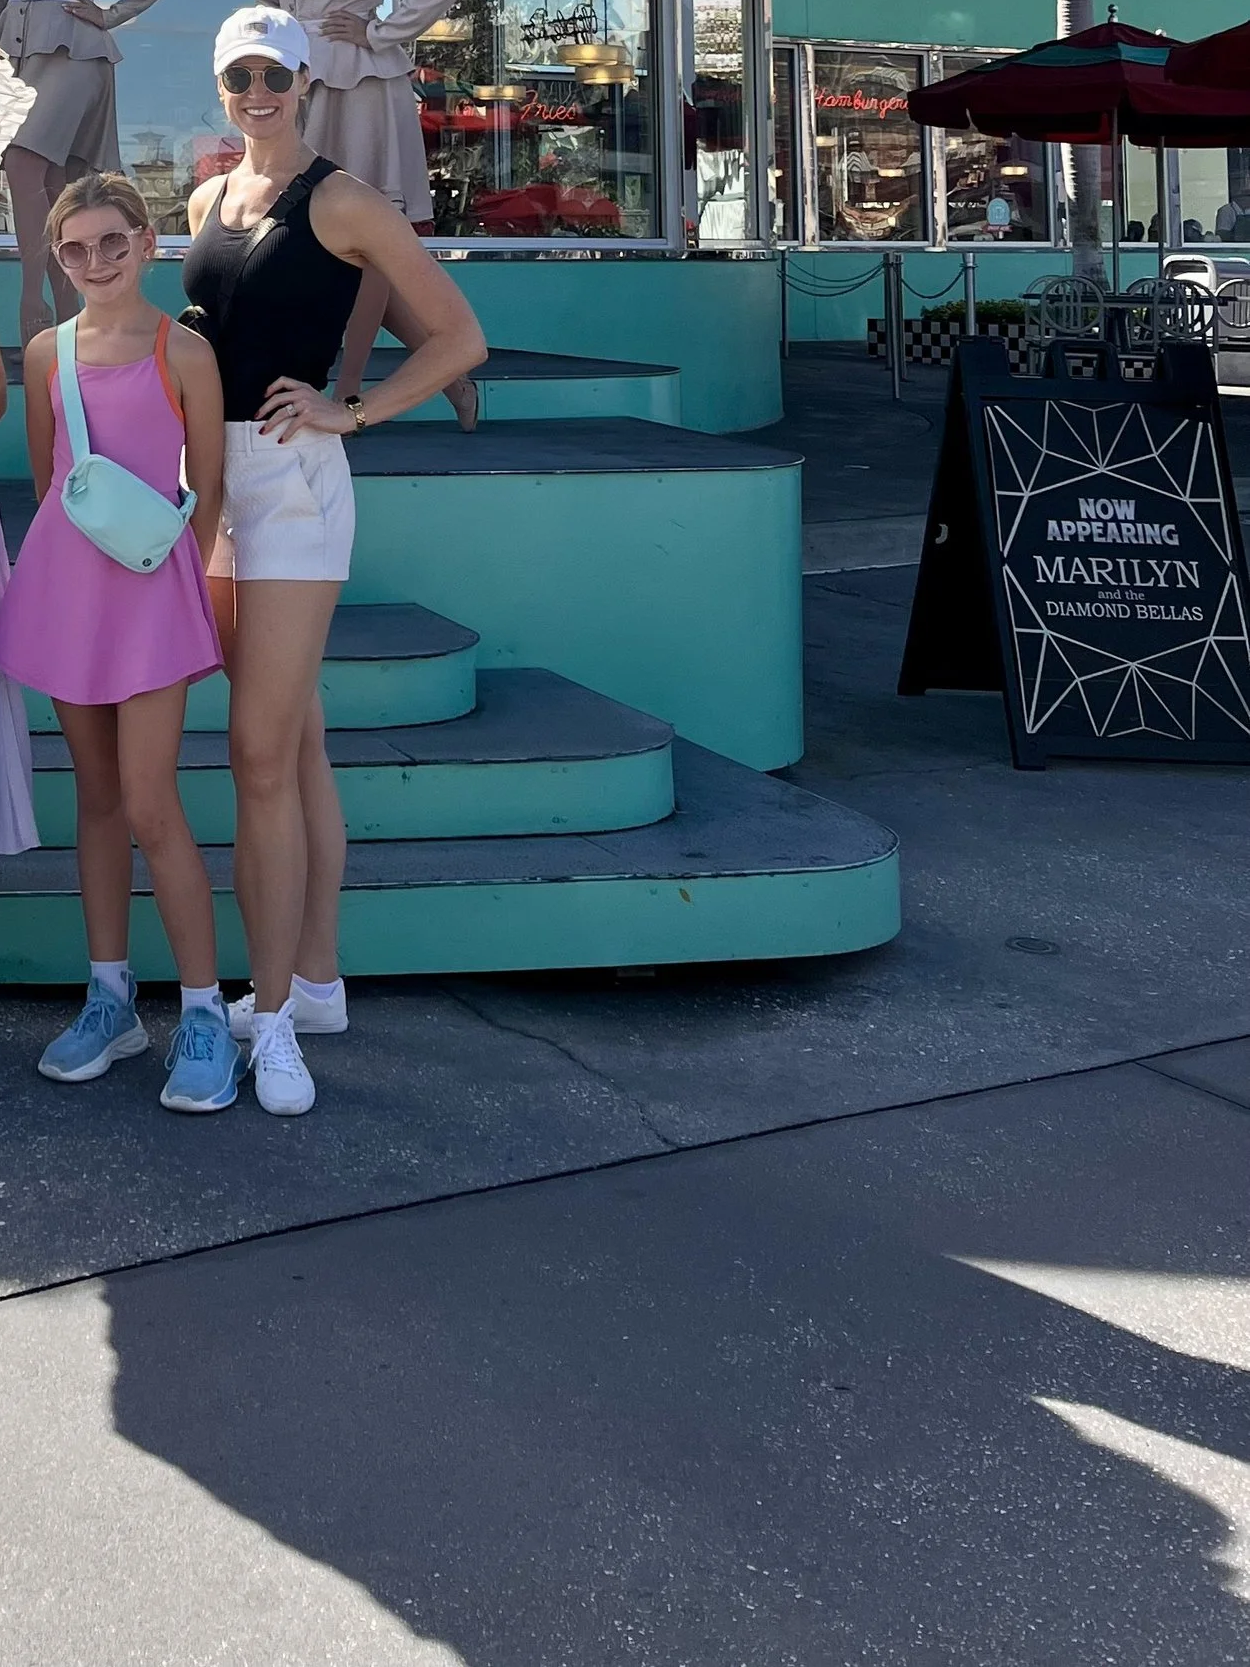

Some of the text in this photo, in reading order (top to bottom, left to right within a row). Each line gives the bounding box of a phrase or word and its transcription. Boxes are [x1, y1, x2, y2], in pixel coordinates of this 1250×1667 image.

[814, 84, 910, 120] Hamburger
[1078, 497, 1136, 521] NOW
[1046, 519, 1180, 546] APPEARING
[1033, 555, 1200, 589] MARILYN
[1097, 589, 1146, 601] and the
[1045, 600, 1204, 622] DIAMOND BELLAS
